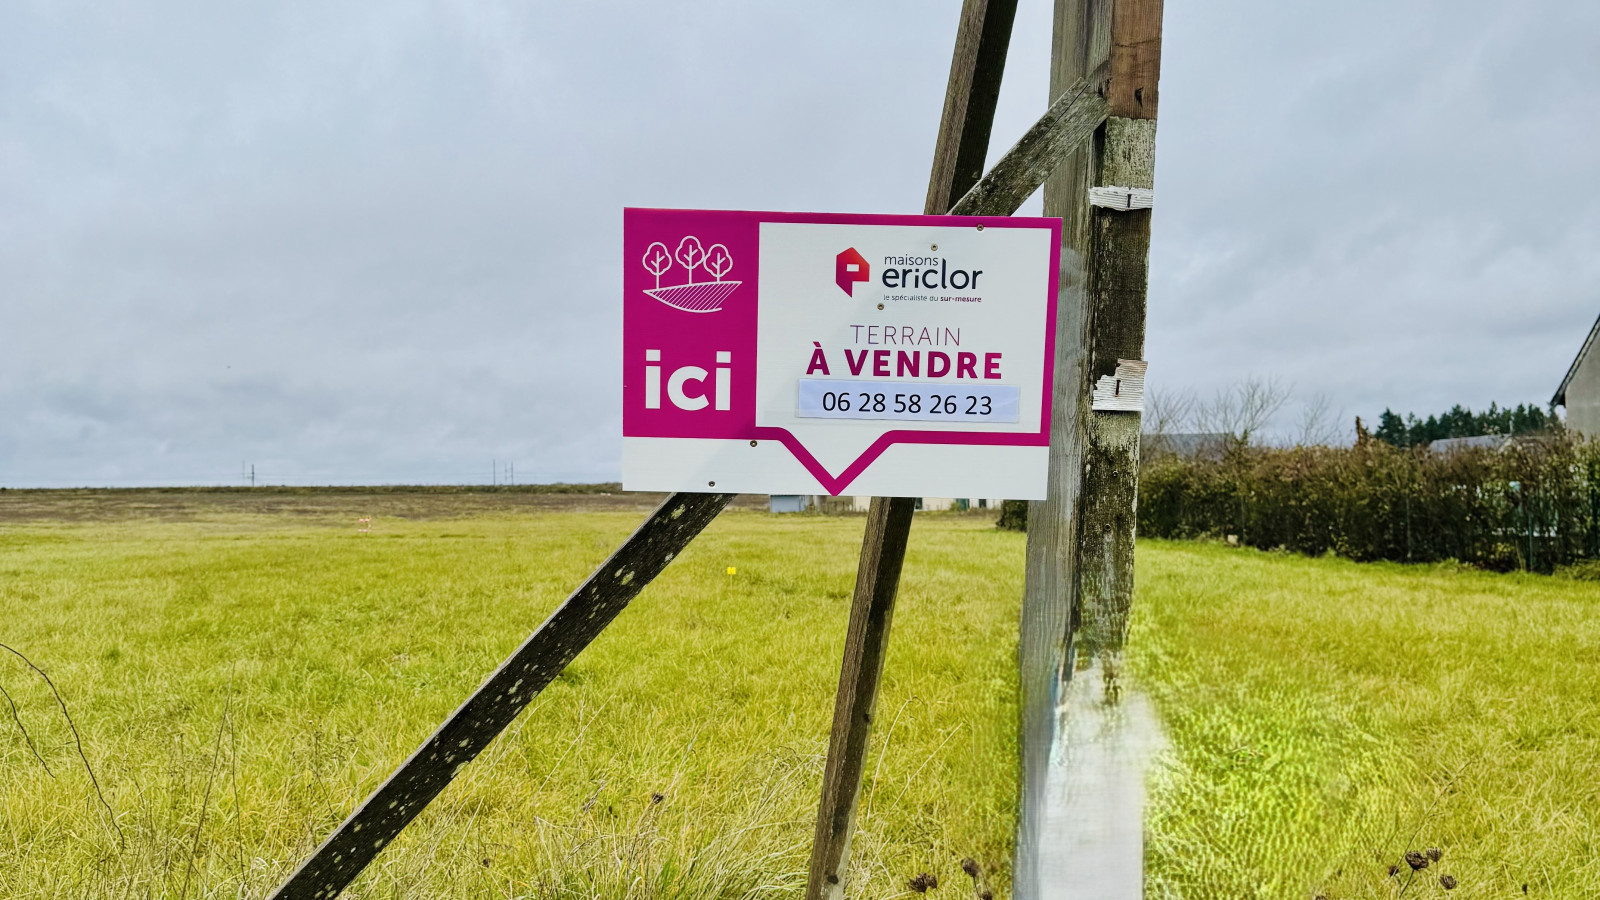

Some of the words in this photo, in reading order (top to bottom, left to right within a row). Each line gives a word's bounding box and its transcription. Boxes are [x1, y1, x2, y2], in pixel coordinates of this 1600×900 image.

[884, 254, 939, 267] maisons
[882, 258, 983, 290] ericlor
[940, 295, 982, 303] sur-mesure
[850, 325, 961, 346] TERRAIN
[806, 341, 830, 376] À
[844, 349, 1003, 380] VENDRE
[645, 349, 732, 412] ici
[822, 391, 851, 412] 06
[858, 392, 886, 413] 28
[893, 393, 921, 414] 58
[929, 394, 957, 415] 26
[965, 395, 992, 416] 23
